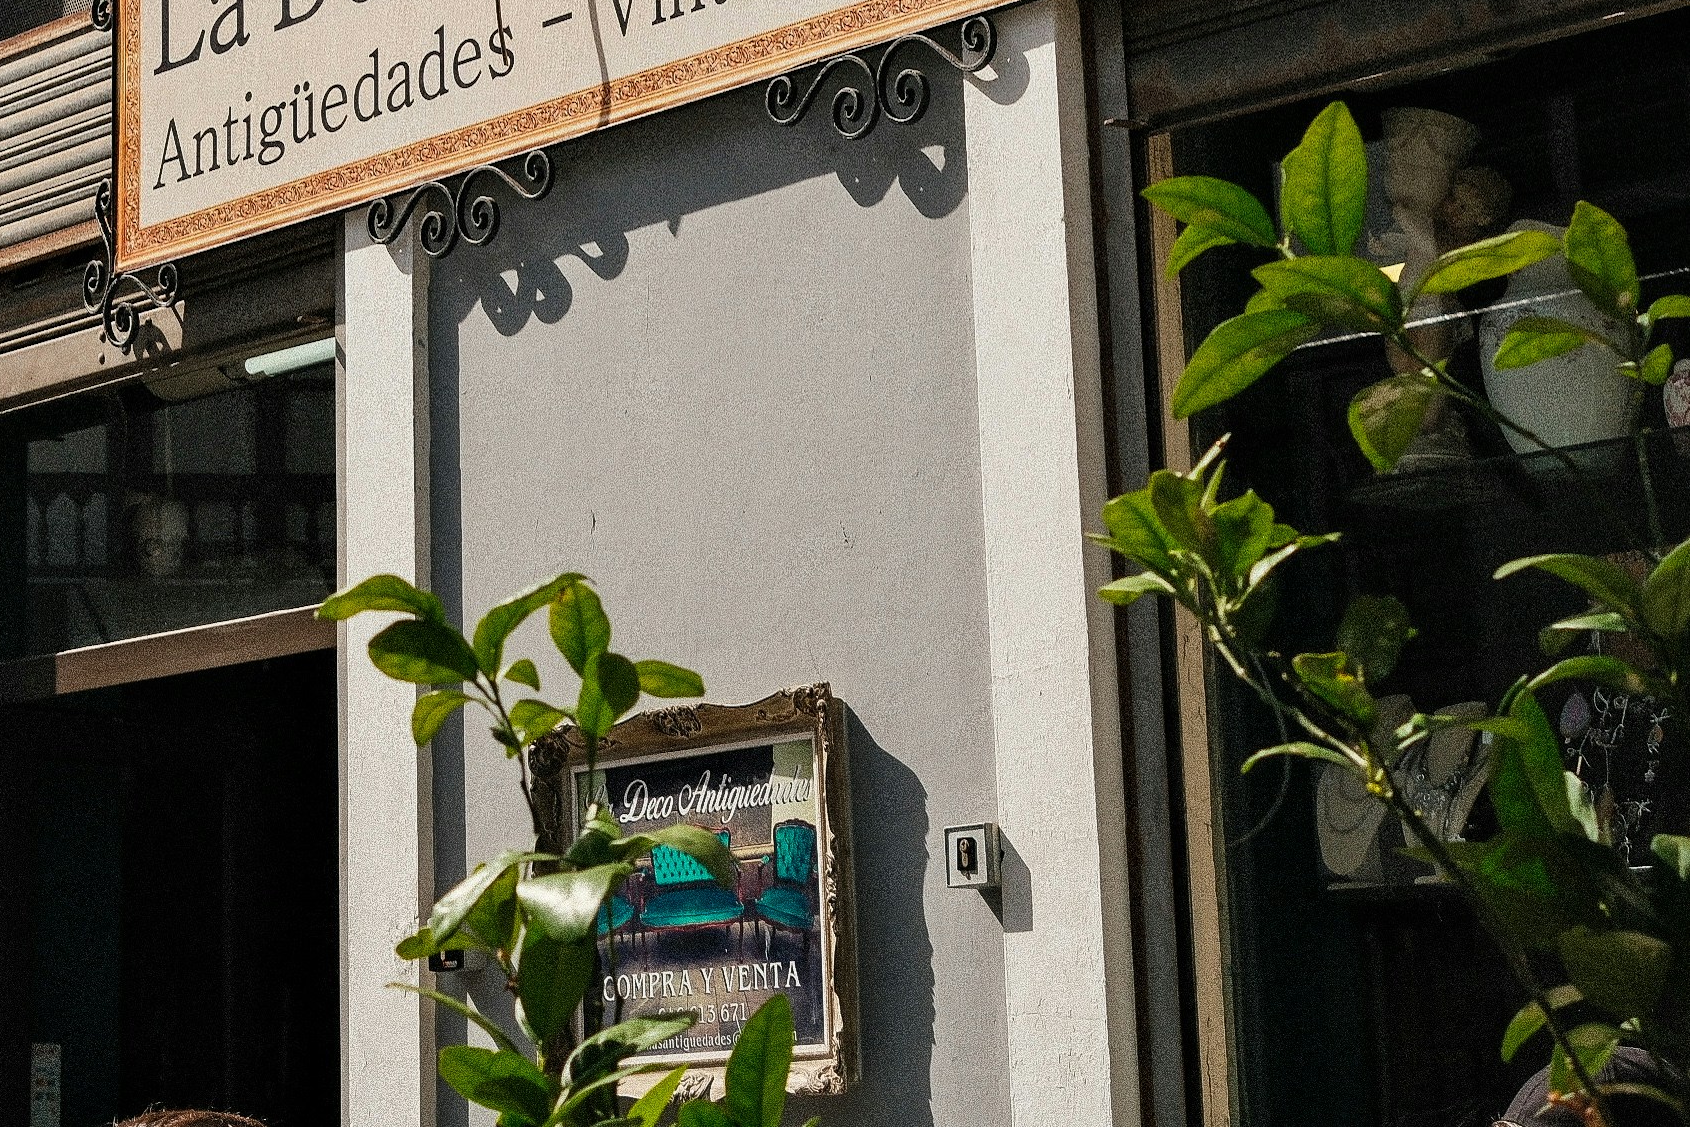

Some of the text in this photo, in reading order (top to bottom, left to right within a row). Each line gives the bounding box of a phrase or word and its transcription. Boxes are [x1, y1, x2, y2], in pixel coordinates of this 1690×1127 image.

[152, 24, 515, 190] Antigüedades
[620, 779, 674, 823] Deco
[678, 765, 814, 824] Antiguedades
[603, 960, 801, 1002] COMPRA Y VENTA
[720, 1003, 748, 1023] 671
